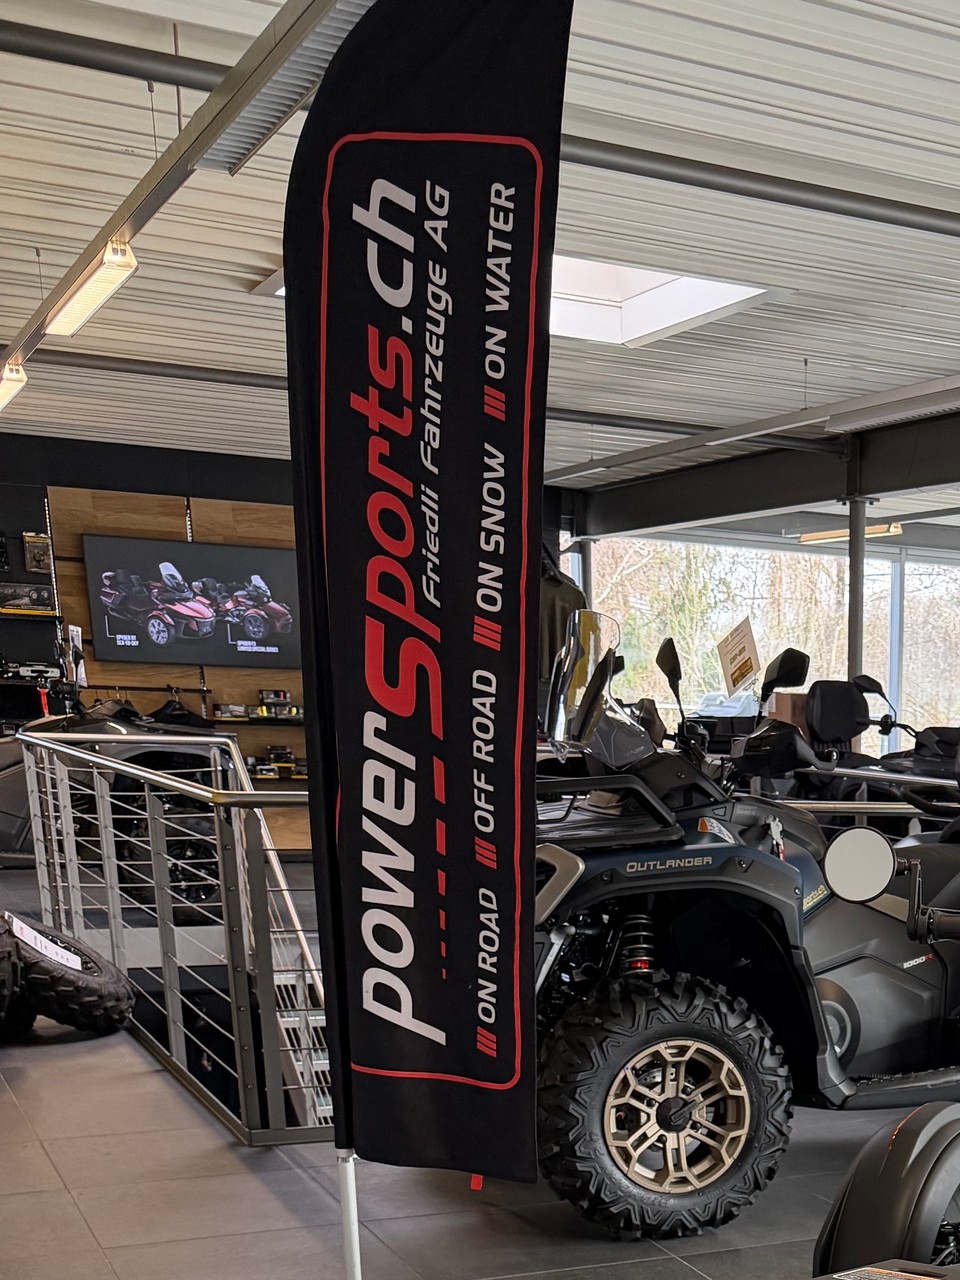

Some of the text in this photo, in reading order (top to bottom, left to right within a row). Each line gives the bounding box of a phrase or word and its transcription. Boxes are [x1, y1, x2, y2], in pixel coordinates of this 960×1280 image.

[485, 182, 516, 380] ON WATER
[419, 180, 453, 608] Friedli Fahrzeuge AG
[476, 442, 505, 613] ON SNOW
[472, 669, 497, 833] OFF ROAD
[626, 856, 713, 873] OUTLANDER
[477, 887, 500, 1024] ON ROAD
[903, 953, 934, 969] 1000R
